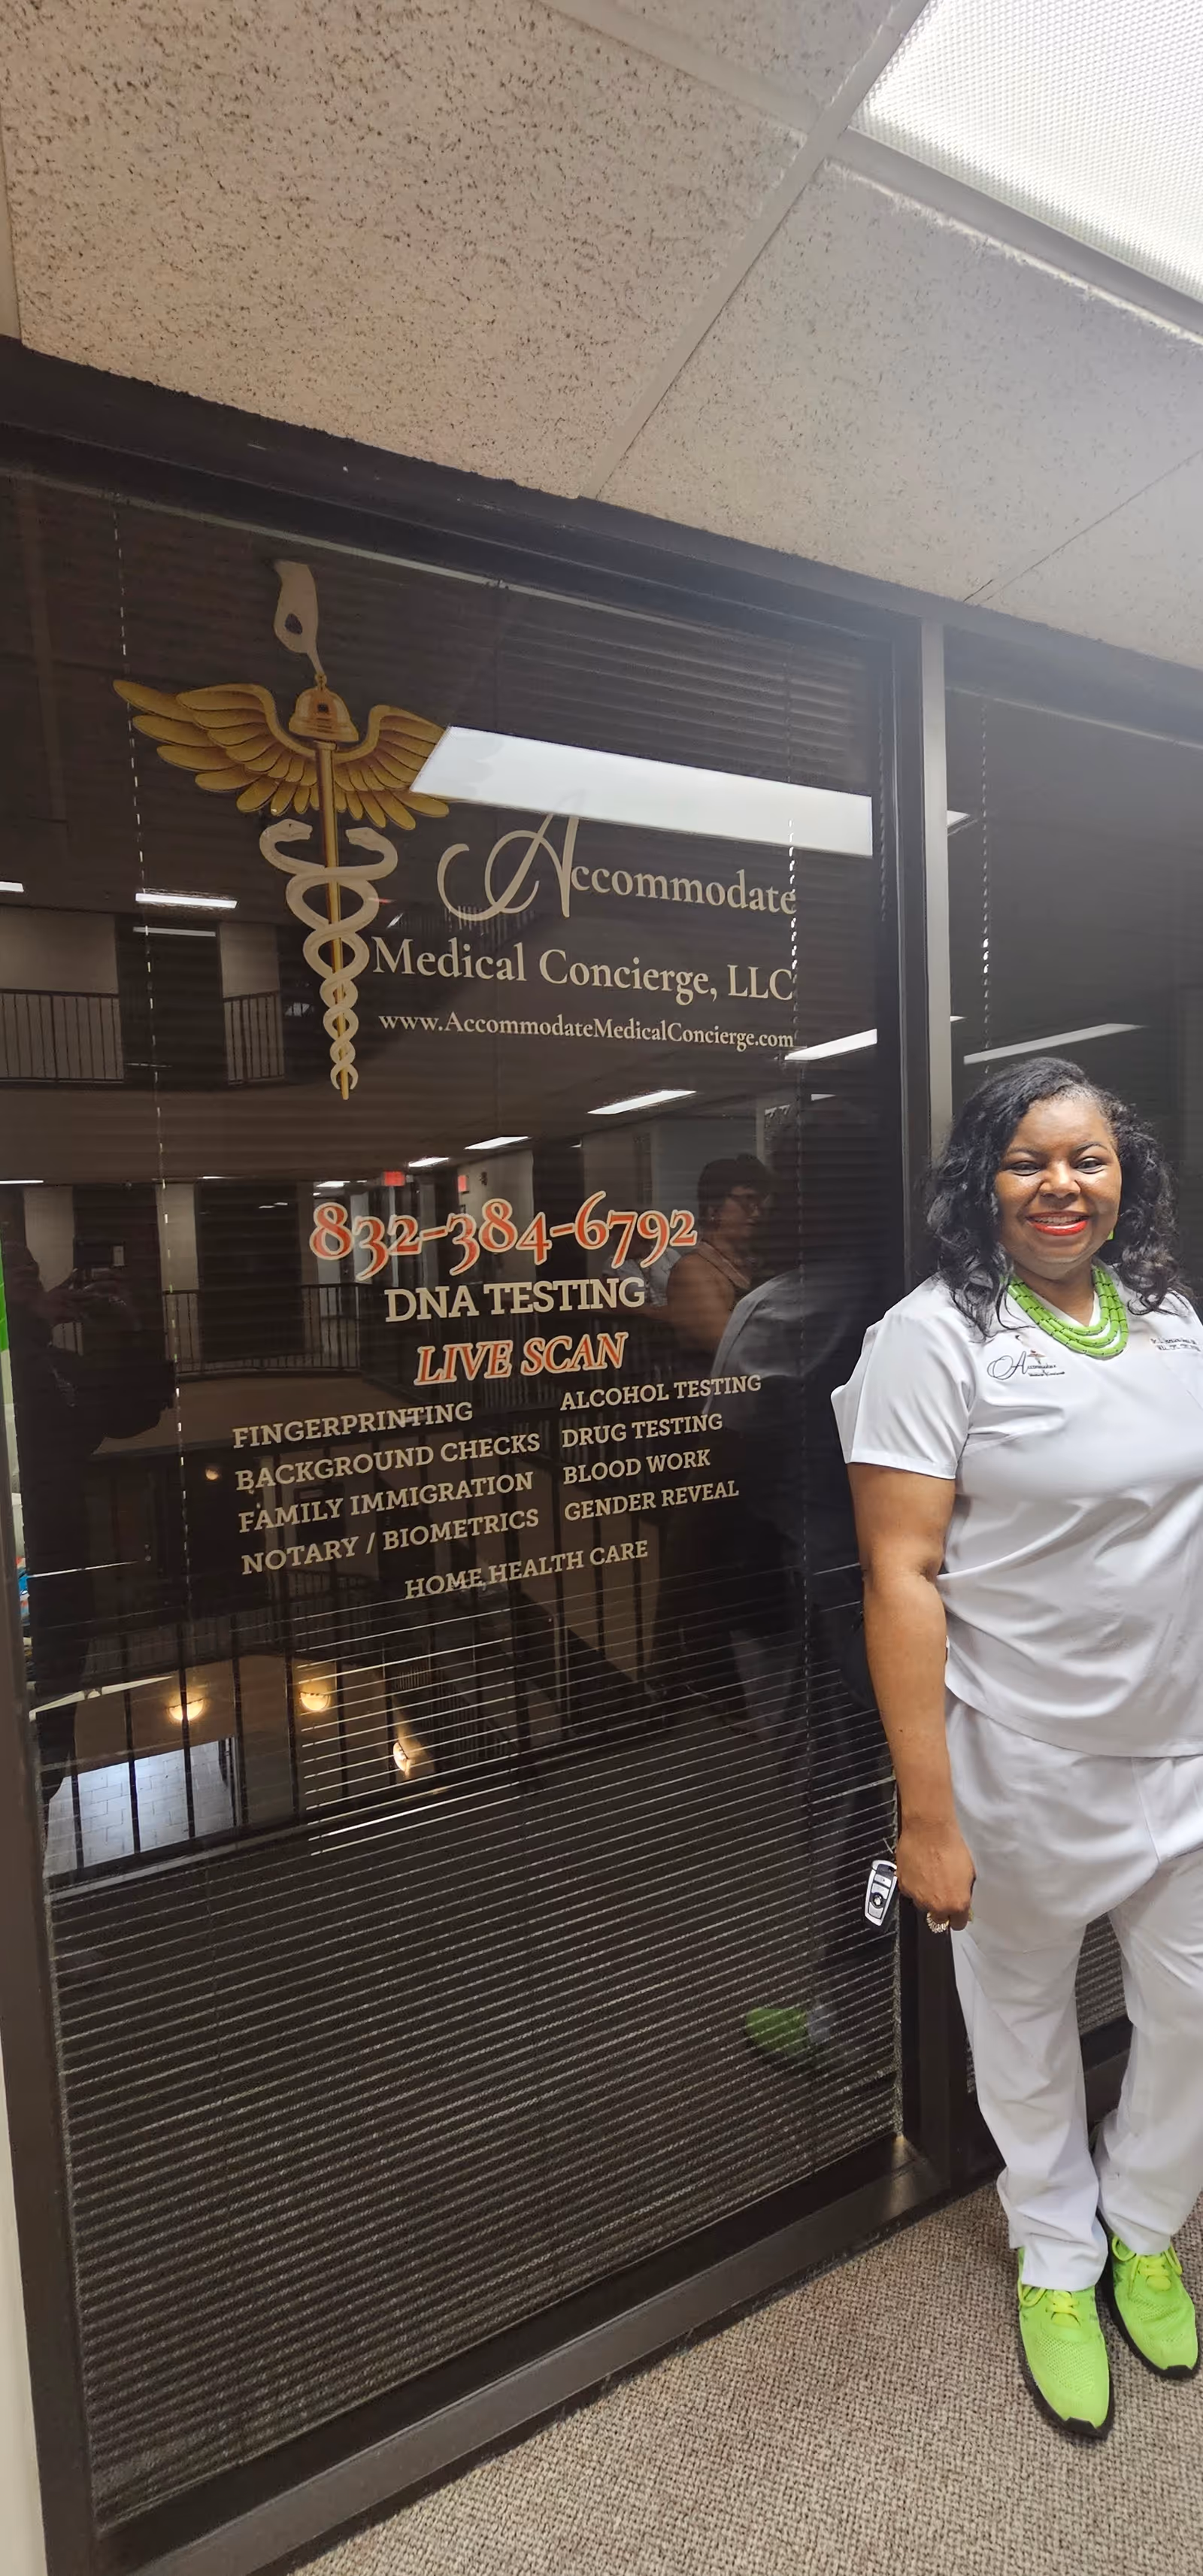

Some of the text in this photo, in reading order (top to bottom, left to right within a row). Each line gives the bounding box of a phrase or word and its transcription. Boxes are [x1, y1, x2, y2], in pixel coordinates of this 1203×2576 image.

[437, 791, 797, 920] Accommodate
[372, 936, 795, 1006] Medical Concierge, LLC
[378, 1011, 794, 1051] www.AccommodateMedicalConcierge.com
[310, 1191, 697, 1280] 832-384-6792
[384, 1277, 645, 1323] DNA TESTING
[414, 1332, 629, 1385] LIVE SCAN
[559, 1374, 762, 1411] ALCOHOL TESTING
[232, 1401, 474, 1450] FINGERPRINTING
[562, 1413, 723, 1448] DRUG TESTING
[235, 1432, 541, 1491] BACKGROUND CHECKS
[562, 1448, 711, 1486] BLOOD WORK
[238, 1471, 534, 1534] FAMILY IMMIGRATION
[564, 1480, 739, 1521] GENDER REVEAL
[241, 1507, 539, 1575] NOTARY / BIOMETRICS
[404, 1539, 649, 1600] HOME HEALTH CARE
